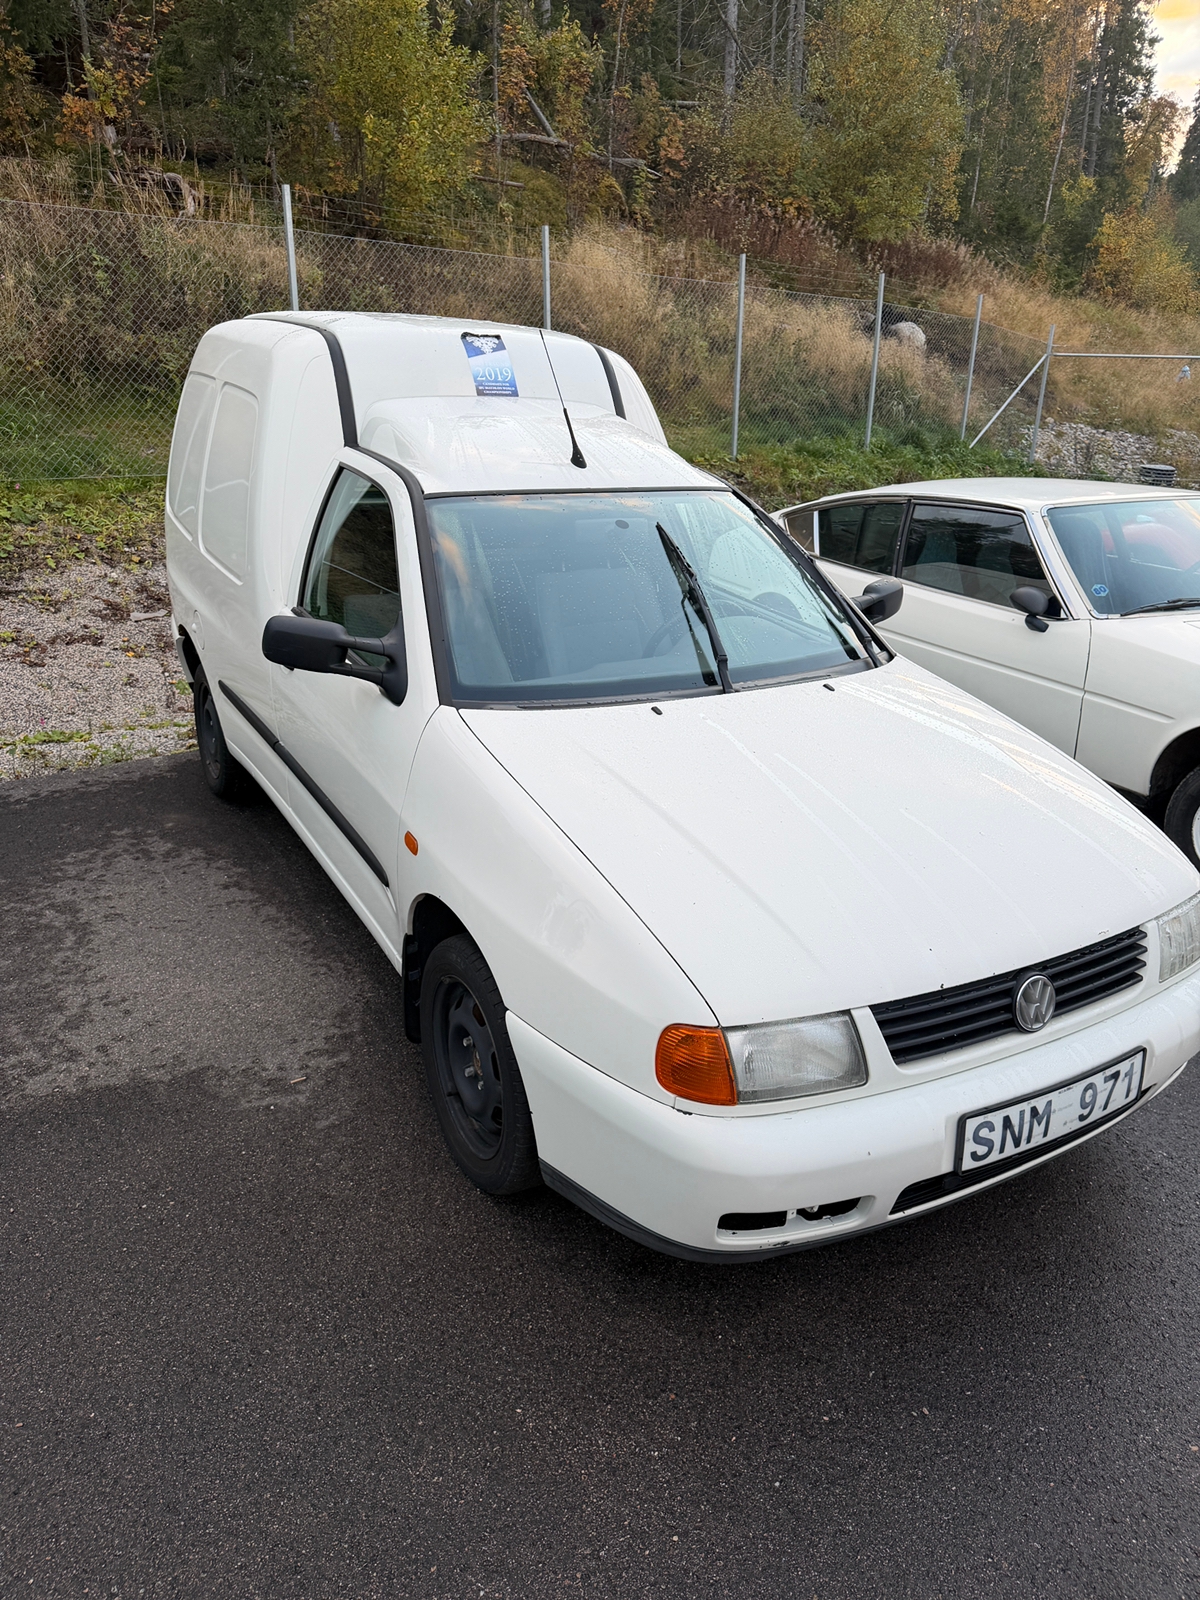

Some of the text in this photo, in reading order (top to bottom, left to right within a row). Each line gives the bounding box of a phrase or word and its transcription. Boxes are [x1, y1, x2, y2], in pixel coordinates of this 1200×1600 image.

[475, 366, 512, 382] 2019
[1093, 585, 1107, 595] 80
[970, 1062, 1135, 1162] SNM 971
